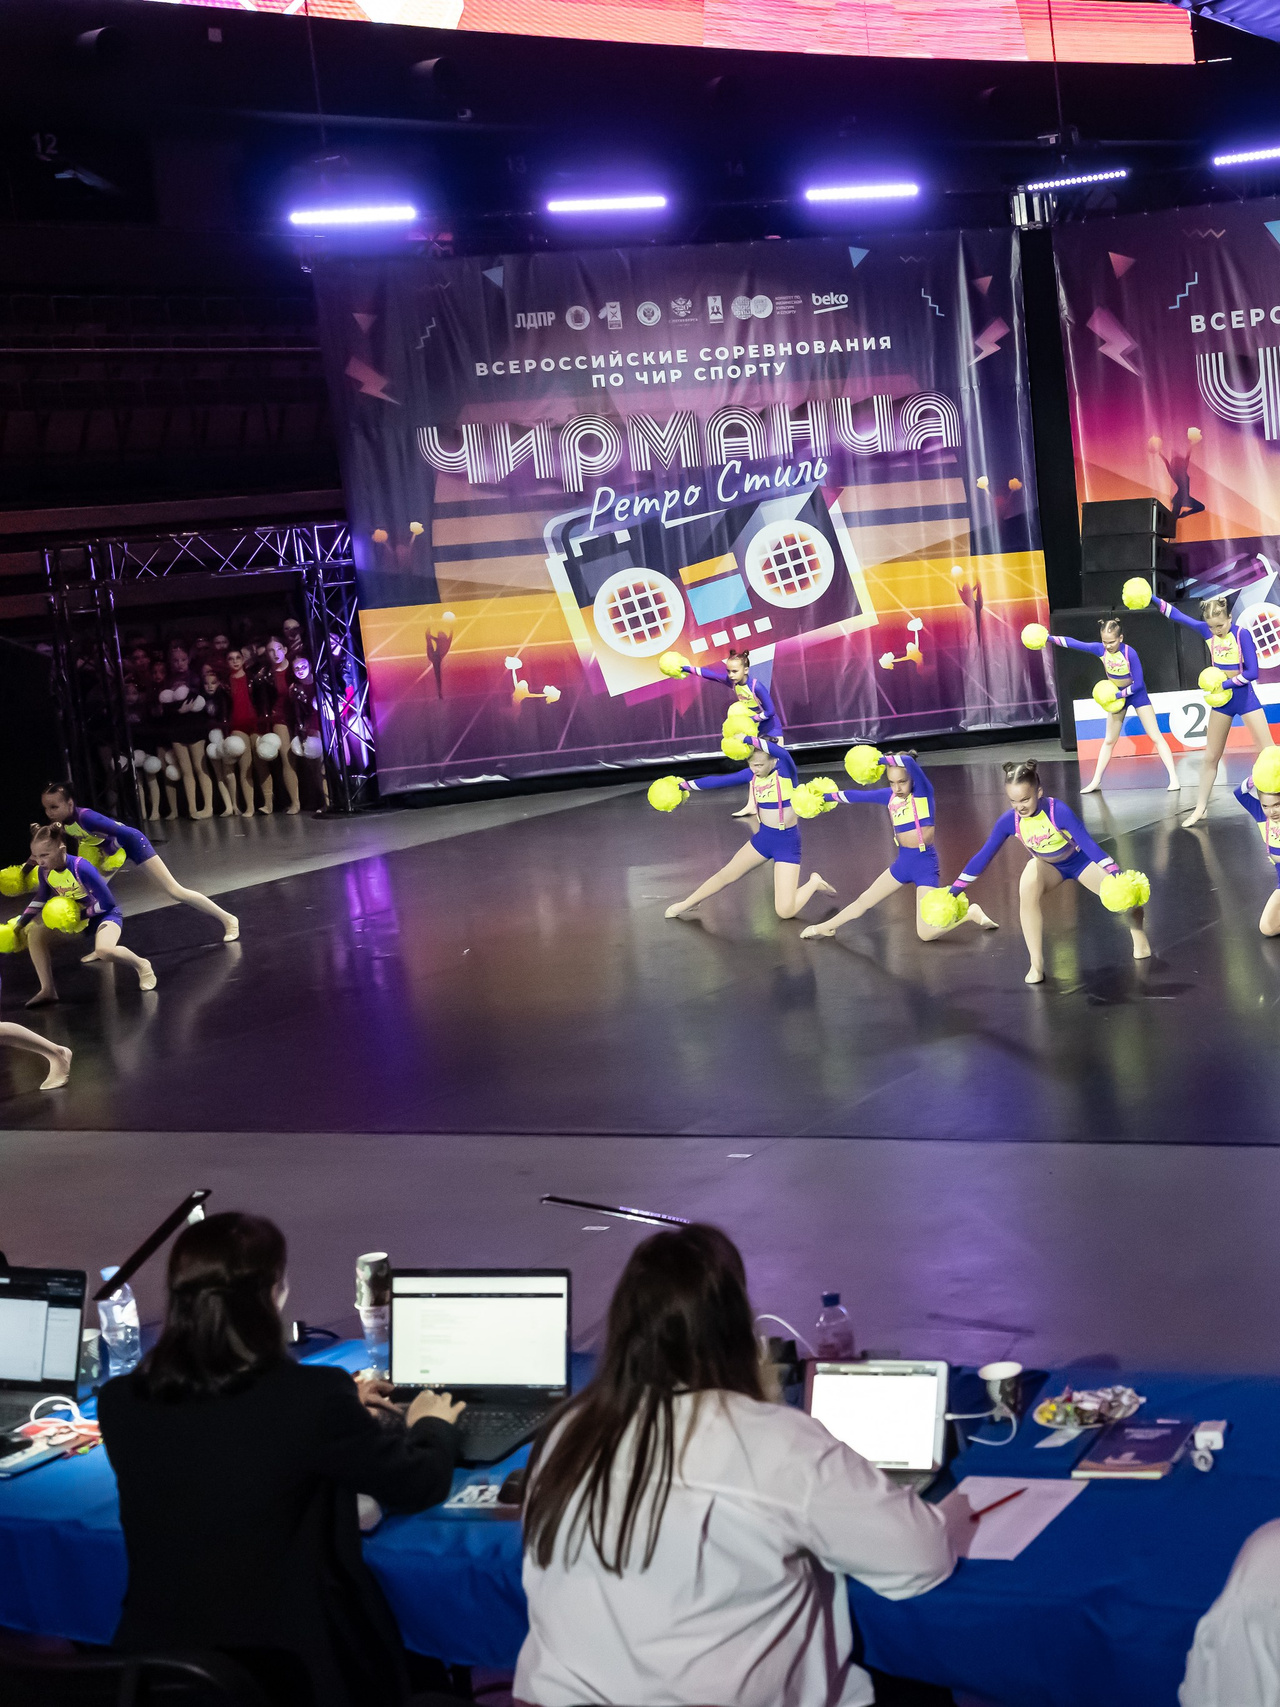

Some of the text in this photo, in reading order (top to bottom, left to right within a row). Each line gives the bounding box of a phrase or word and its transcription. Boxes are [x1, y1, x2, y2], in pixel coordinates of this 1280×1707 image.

[31, 131, 58, 154] 12
[811, 292, 849, 306] beko
[514, 311, 556, 330] ЛДПР
[475, 335, 894, 377] ВСЕРОССИЙСКИЕ СОРЕВНОВАНИЯ
[591, 362, 788, 388] ПО ЧИР СПОРТУ
[589, 457, 829, 532] Ретро Стиль
[1181, 702, 1208, 738] 2
